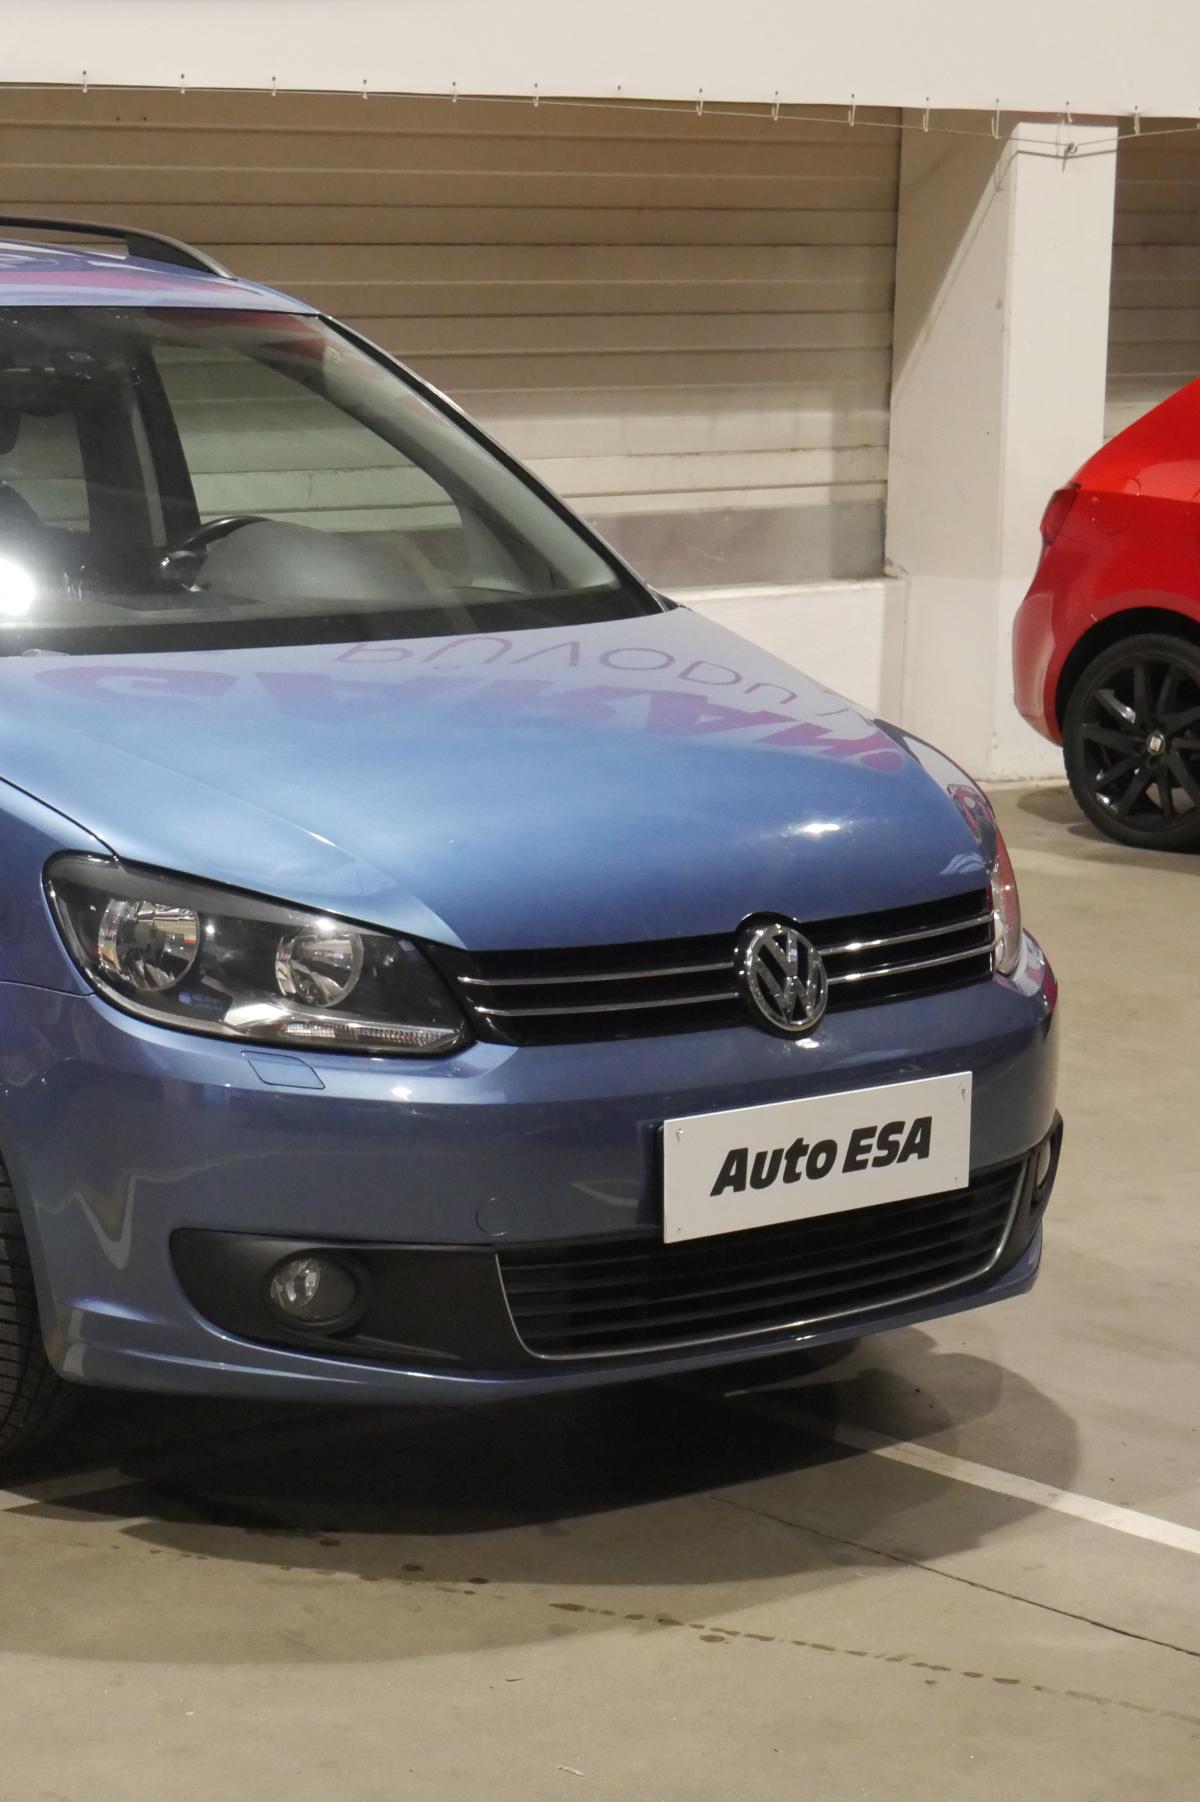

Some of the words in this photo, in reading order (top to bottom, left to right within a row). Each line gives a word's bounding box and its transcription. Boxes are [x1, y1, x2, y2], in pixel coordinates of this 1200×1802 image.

[746, 925, 828, 1031] VW
[710, 1137, 837, 1197] Auto
[842, 1116, 932, 1173] ESA
